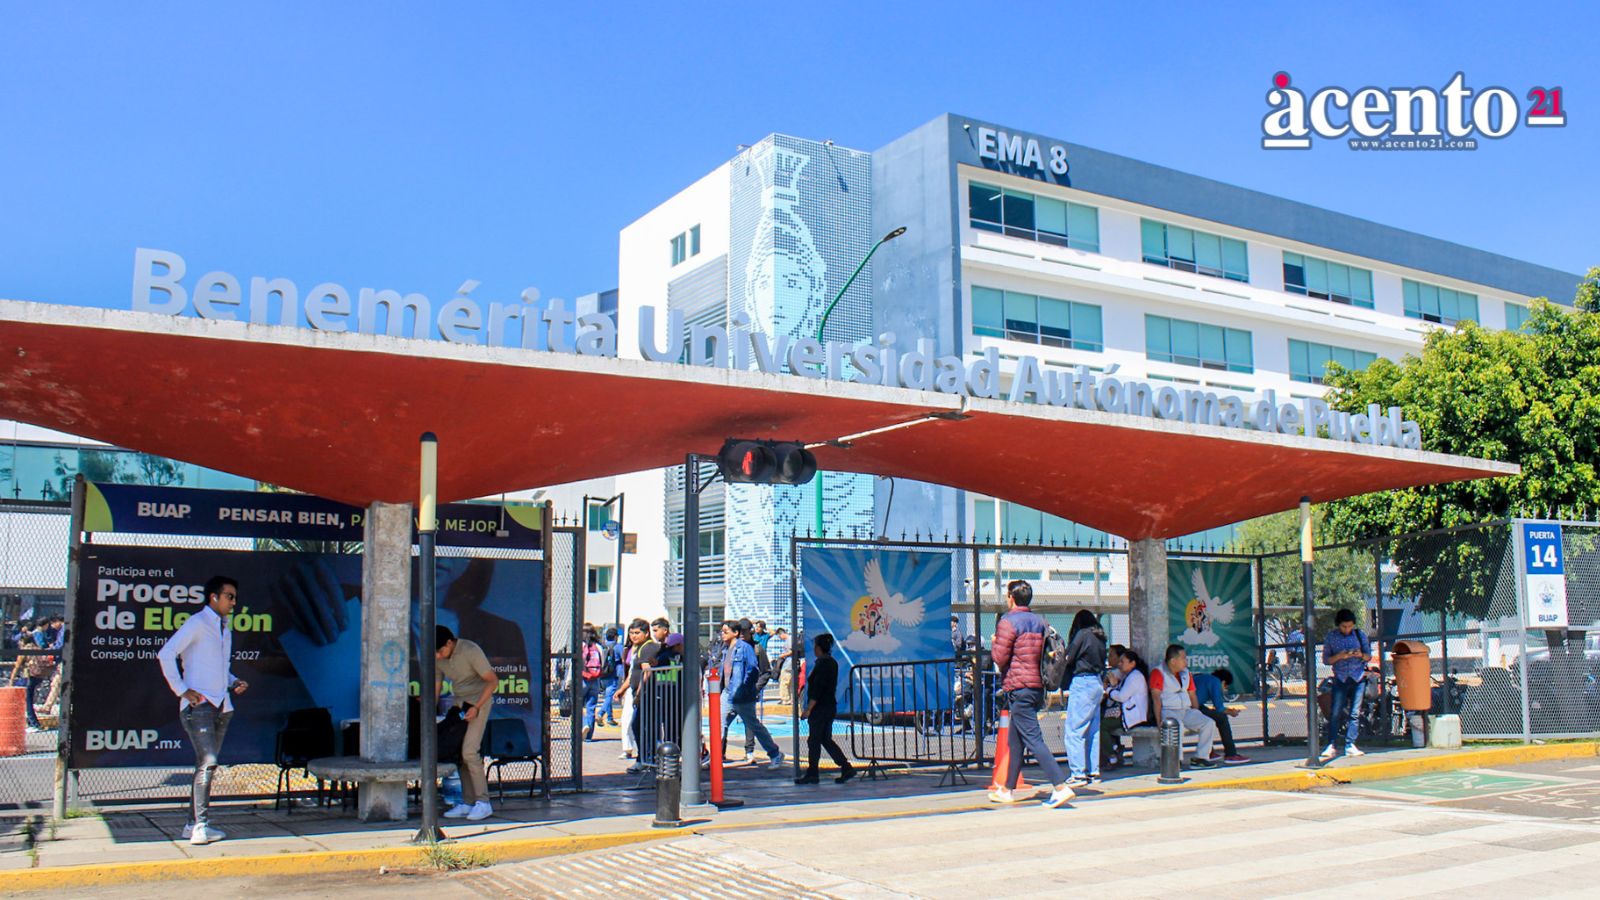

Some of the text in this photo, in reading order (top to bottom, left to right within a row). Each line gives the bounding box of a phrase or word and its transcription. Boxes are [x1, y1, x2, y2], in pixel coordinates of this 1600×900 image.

[978, 127, 1068, 175] EMA 8
[132, 247, 1422, 451] Benemérita Universidad Autónoma de Puebla
[137, 501, 191, 519] BUAP
[218, 507, 293, 523] PENSAR
[298, 511, 345, 529] BIEN,
[445, 518, 497, 532] MEJOR
[1529, 531, 1555, 539] PUERTA
[1531, 544, 1557, 567] 14
[98, 566, 175, 578] Participa en el
[97, 578, 206, 604] Proces
[95, 605, 272, 632] de Eleión
[1538, 614, 1558, 623] BUAP
[91, 636, 105, 646] de
[108, 636, 124, 646] las
[127, 638, 134, 648] y
[136, 636, 152, 646] los
[91, 649, 135, 661] Consejo
[1186, 655, 1230, 669] TEQUIOS
[519, 664, 527, 672] la
[507, 697, 529, 705] mayo
[86, 729, 182, 750] BUAP.mx
